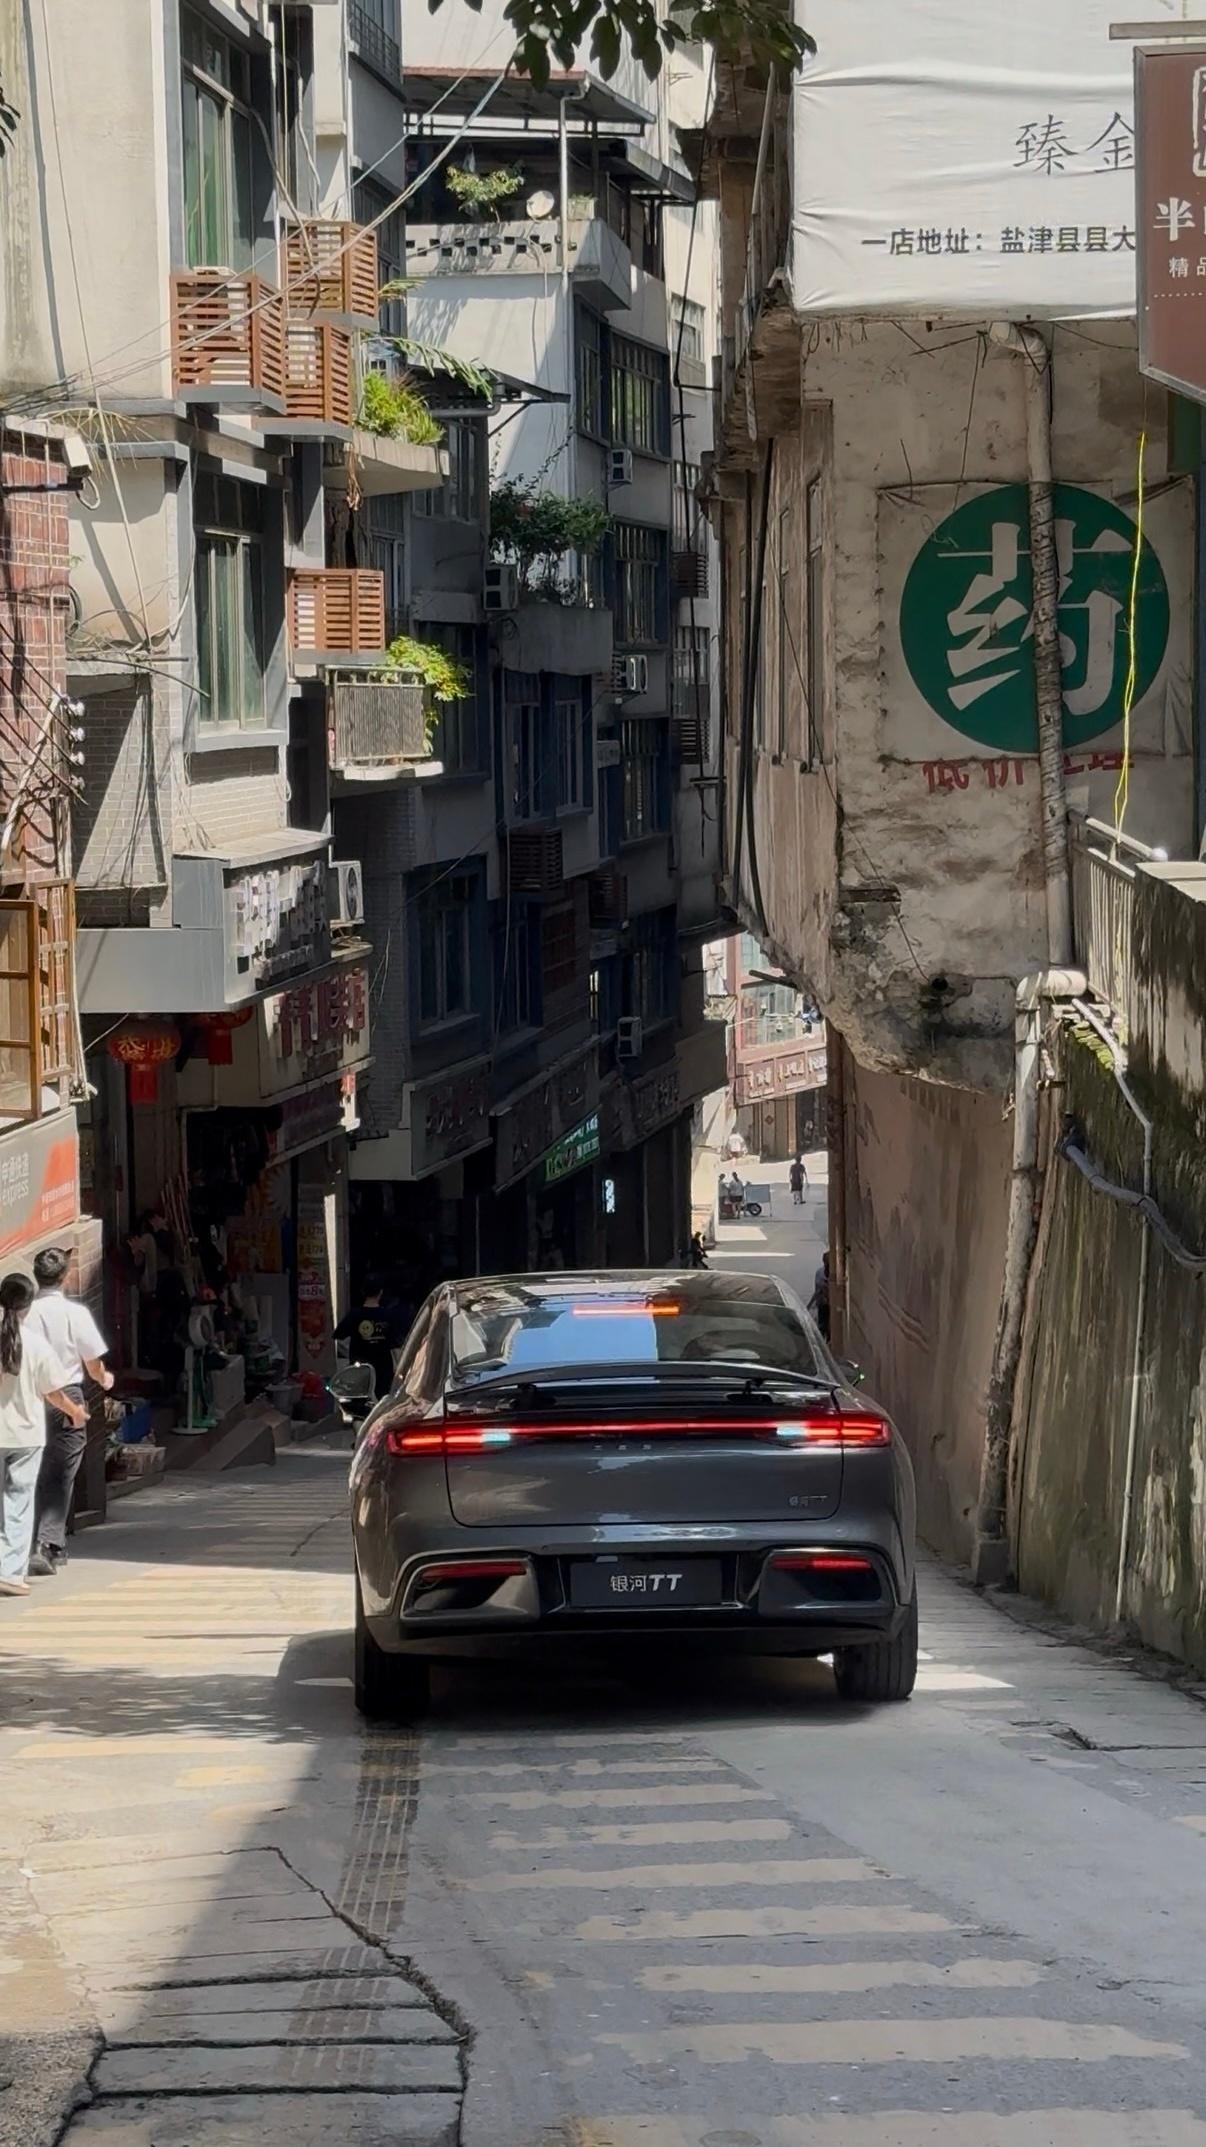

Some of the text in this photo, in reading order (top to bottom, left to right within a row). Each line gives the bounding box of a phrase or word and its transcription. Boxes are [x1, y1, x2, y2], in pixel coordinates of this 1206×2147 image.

[1152, 196, 1206, 242] 半
[937, 519, 1133, 716] 药
[609, 1574, 684, 1593] 银河TT
